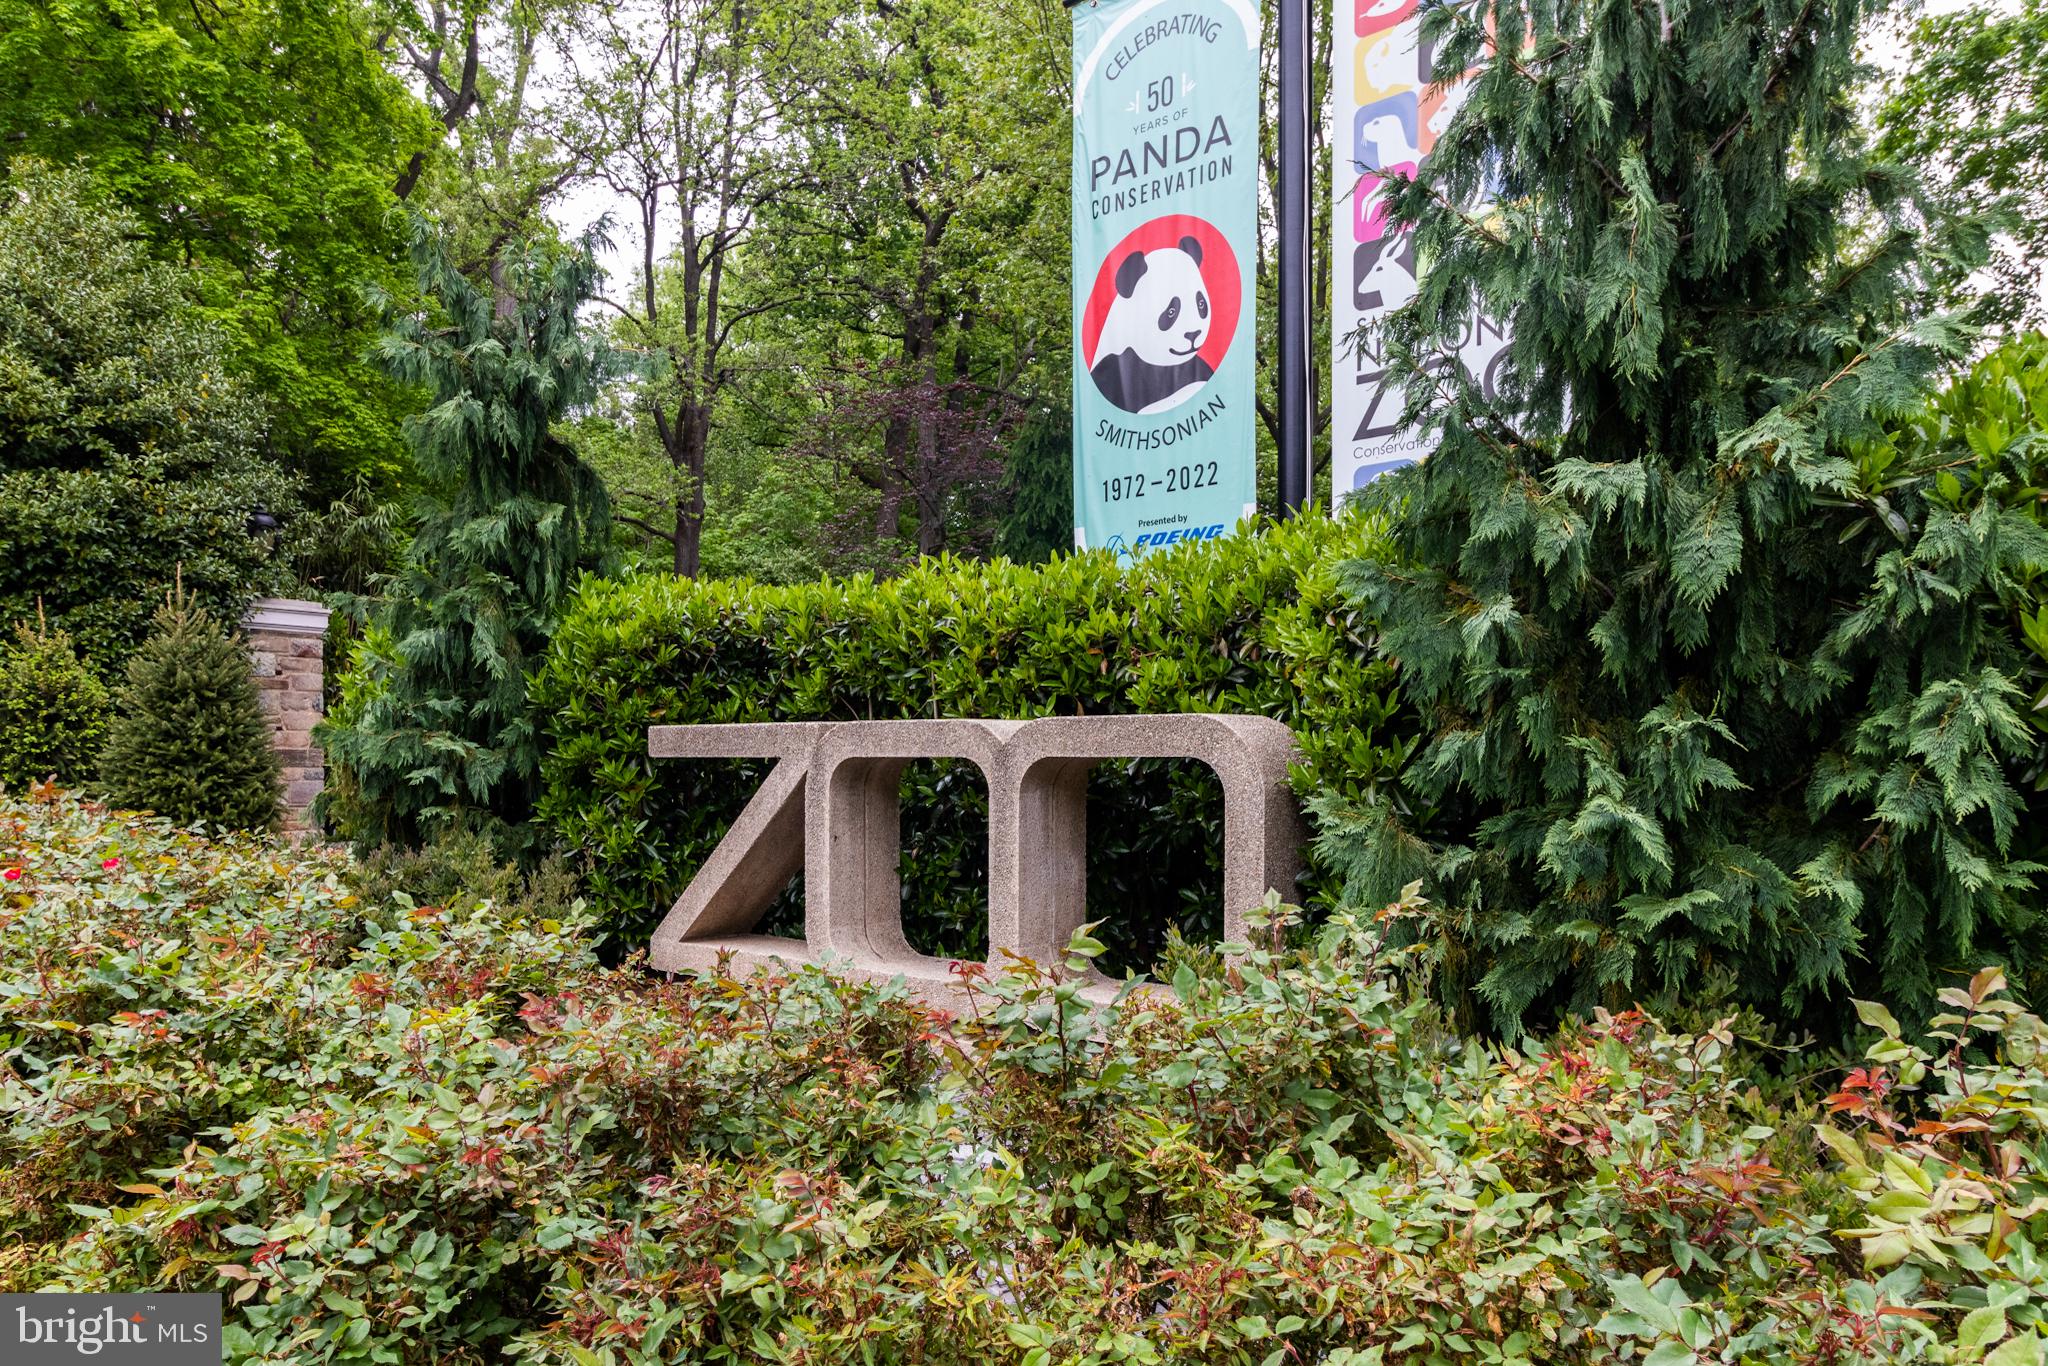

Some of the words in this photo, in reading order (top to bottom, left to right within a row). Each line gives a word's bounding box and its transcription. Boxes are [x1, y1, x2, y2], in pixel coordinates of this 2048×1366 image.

[1105, 14, 1222, 81] CELEBRATING
[1133, 116, 1169, 136] YEARS
[1173, 107, 1189, 121] OF
[1147, 75, 1174, 112] 50
[1091, 114, 1233, 192] PANDA
[1091, 155, 1233, 220] CONSERVATION
[1095, 394, 1226, 450] SMITHSONIAN
[1135, 523, 1225, 548] BOEING
[1138, 515, 1176, 528] Presented
[1177, 514, 1188, 524] by
[648, 714, 1300, 1040] ZOO
